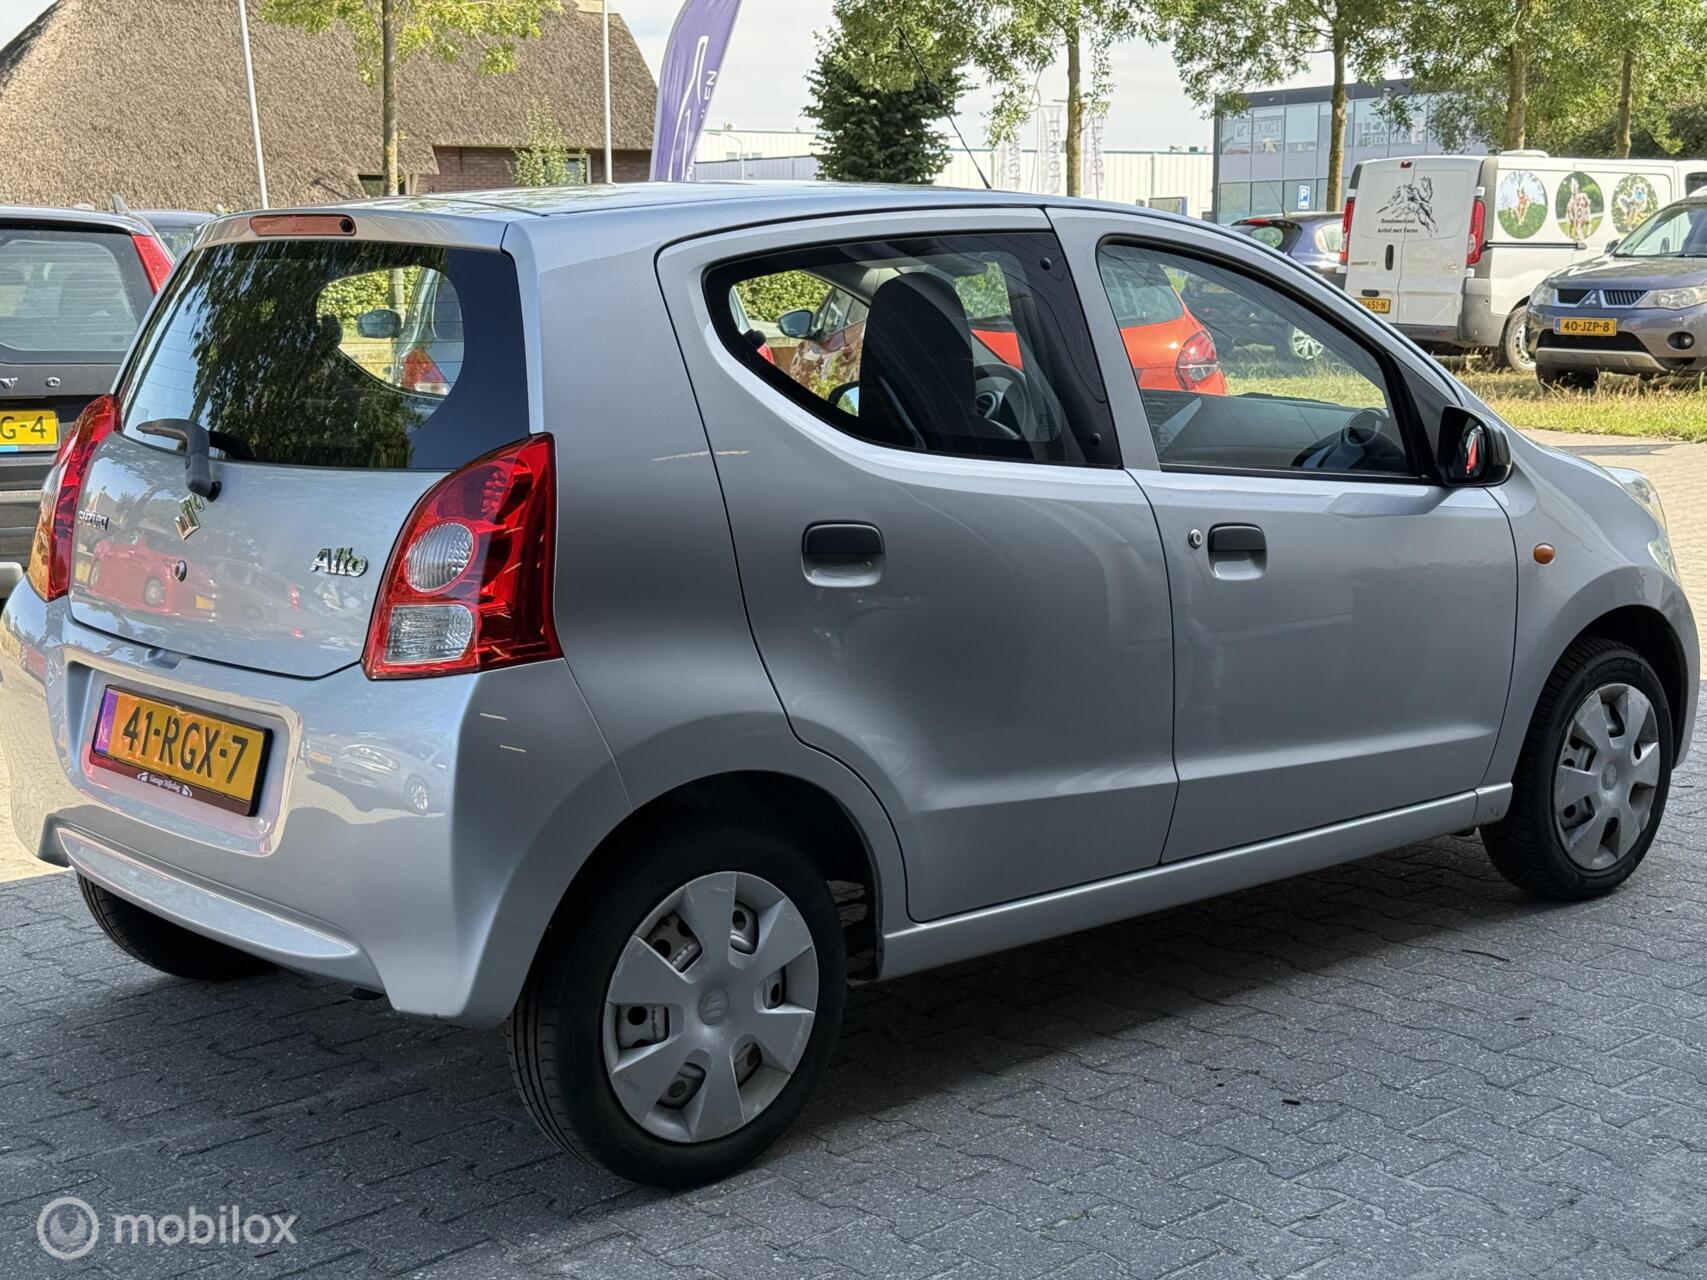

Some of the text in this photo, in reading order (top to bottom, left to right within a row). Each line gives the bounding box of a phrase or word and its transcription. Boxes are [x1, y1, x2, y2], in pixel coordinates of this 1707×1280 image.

[1008, 142, 1020, 181] XACT
[1048, 120, 1060, 179] LEXACT
[1300, 188, 1308, 201] P
[1564, 320, 1610, 332] 40-JZP-8
[310, 547, 369, 578] Alto
[123, 706, 249, 785] 41-RGX-7
